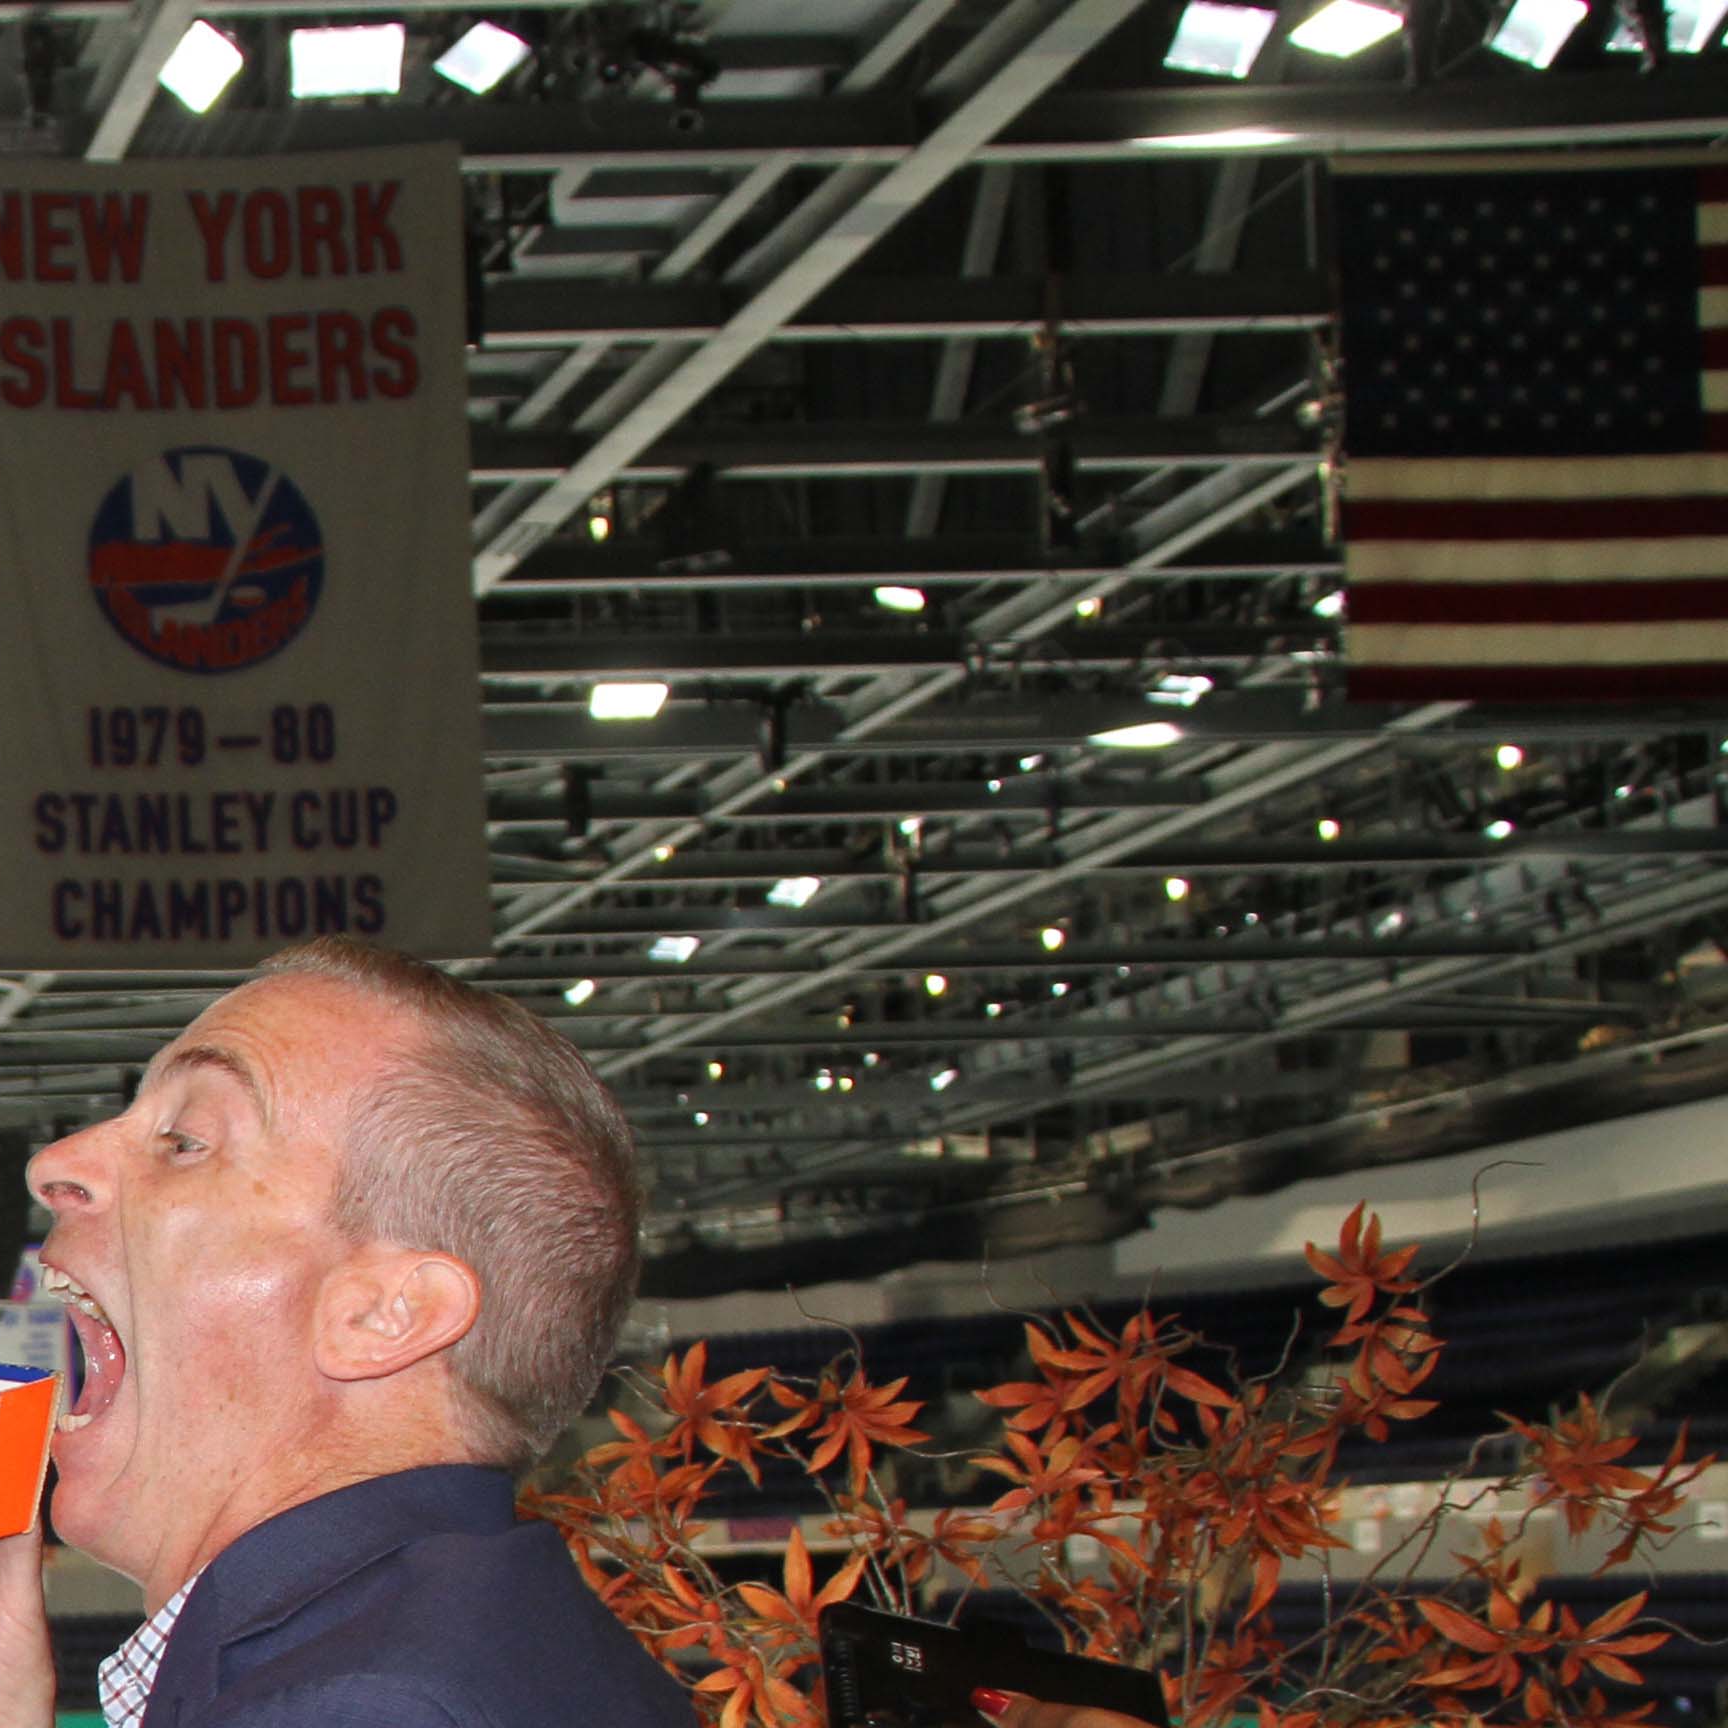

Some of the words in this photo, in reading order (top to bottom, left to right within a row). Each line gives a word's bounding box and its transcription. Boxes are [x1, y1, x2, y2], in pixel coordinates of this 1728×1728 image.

[184, 180, 405, 284] YORK
[132, 454, 283, 541] NY
[34, 792, 277, 856] STANLEY
[290, 786, 398, 852] CUP
[53, 875, 387, 943] CHAMPIONS
